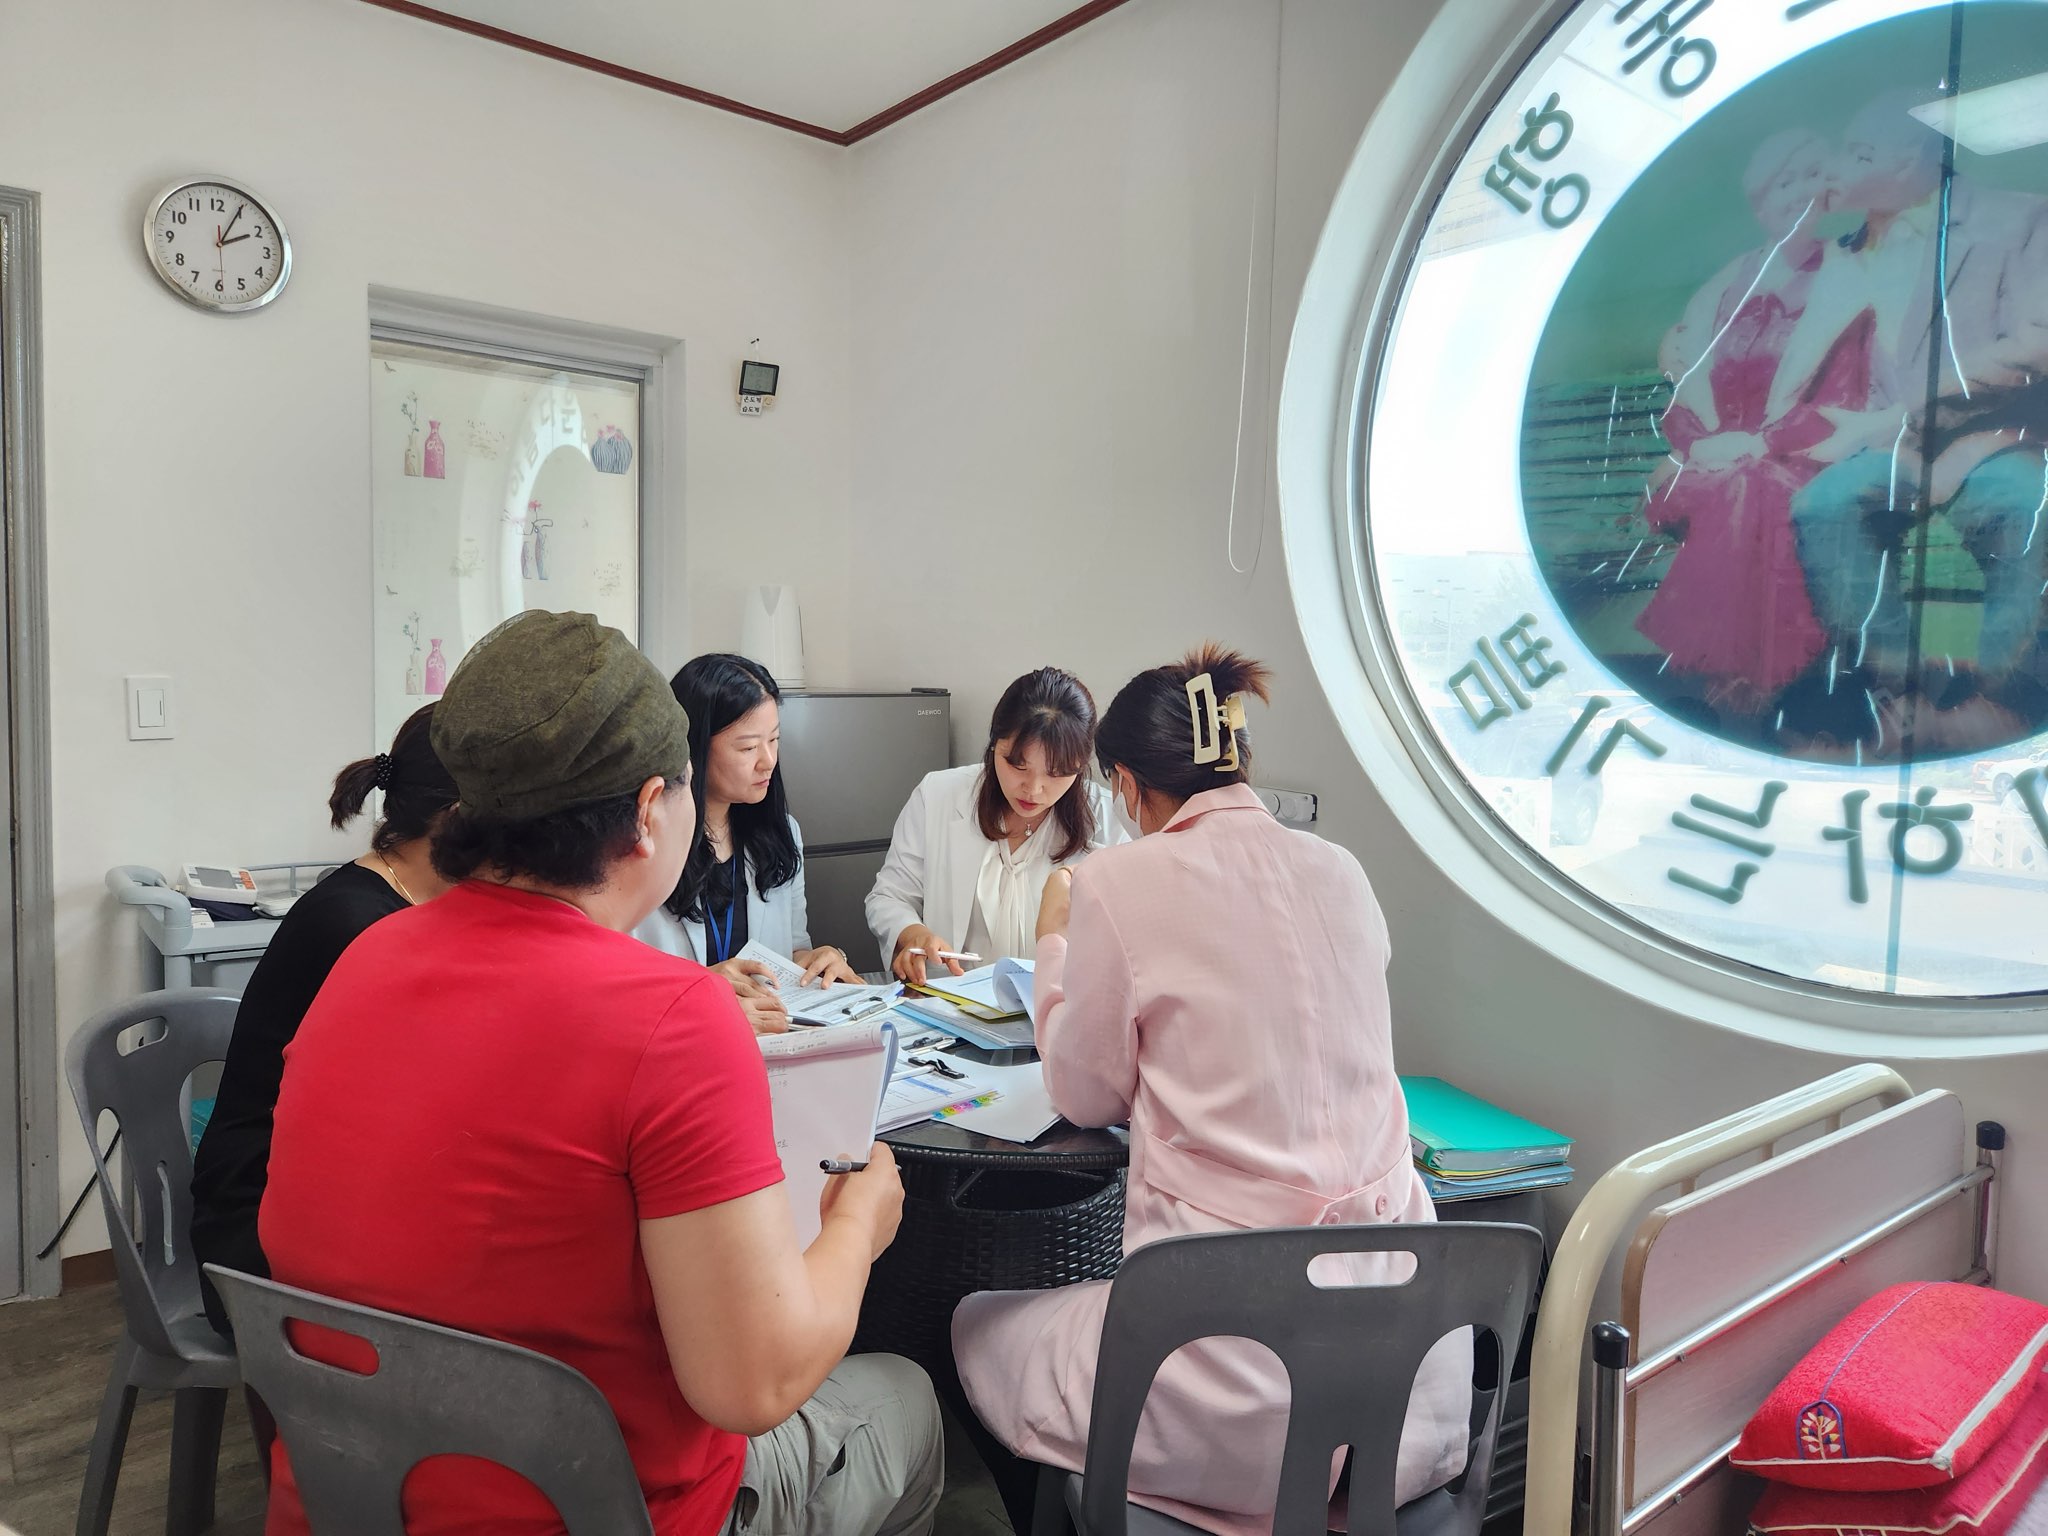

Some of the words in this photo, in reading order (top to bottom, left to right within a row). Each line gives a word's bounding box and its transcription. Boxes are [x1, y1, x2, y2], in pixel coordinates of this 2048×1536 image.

[188, 197, 201, 212] 11
[210, 198, 225, 213] 12
[172, 210, 187, 225] 10
[165, 230, 175, 244] 9
[254, 225, 263, 239] 2
[175, 252, 185, 266] 8
[262, 246, 271, 260] 3
[191, 270, 200, 283] 7
[254, 266, 264, 279] 4
[214, 279, 224, 292] 6
[237, 278, 246, 291] 5
